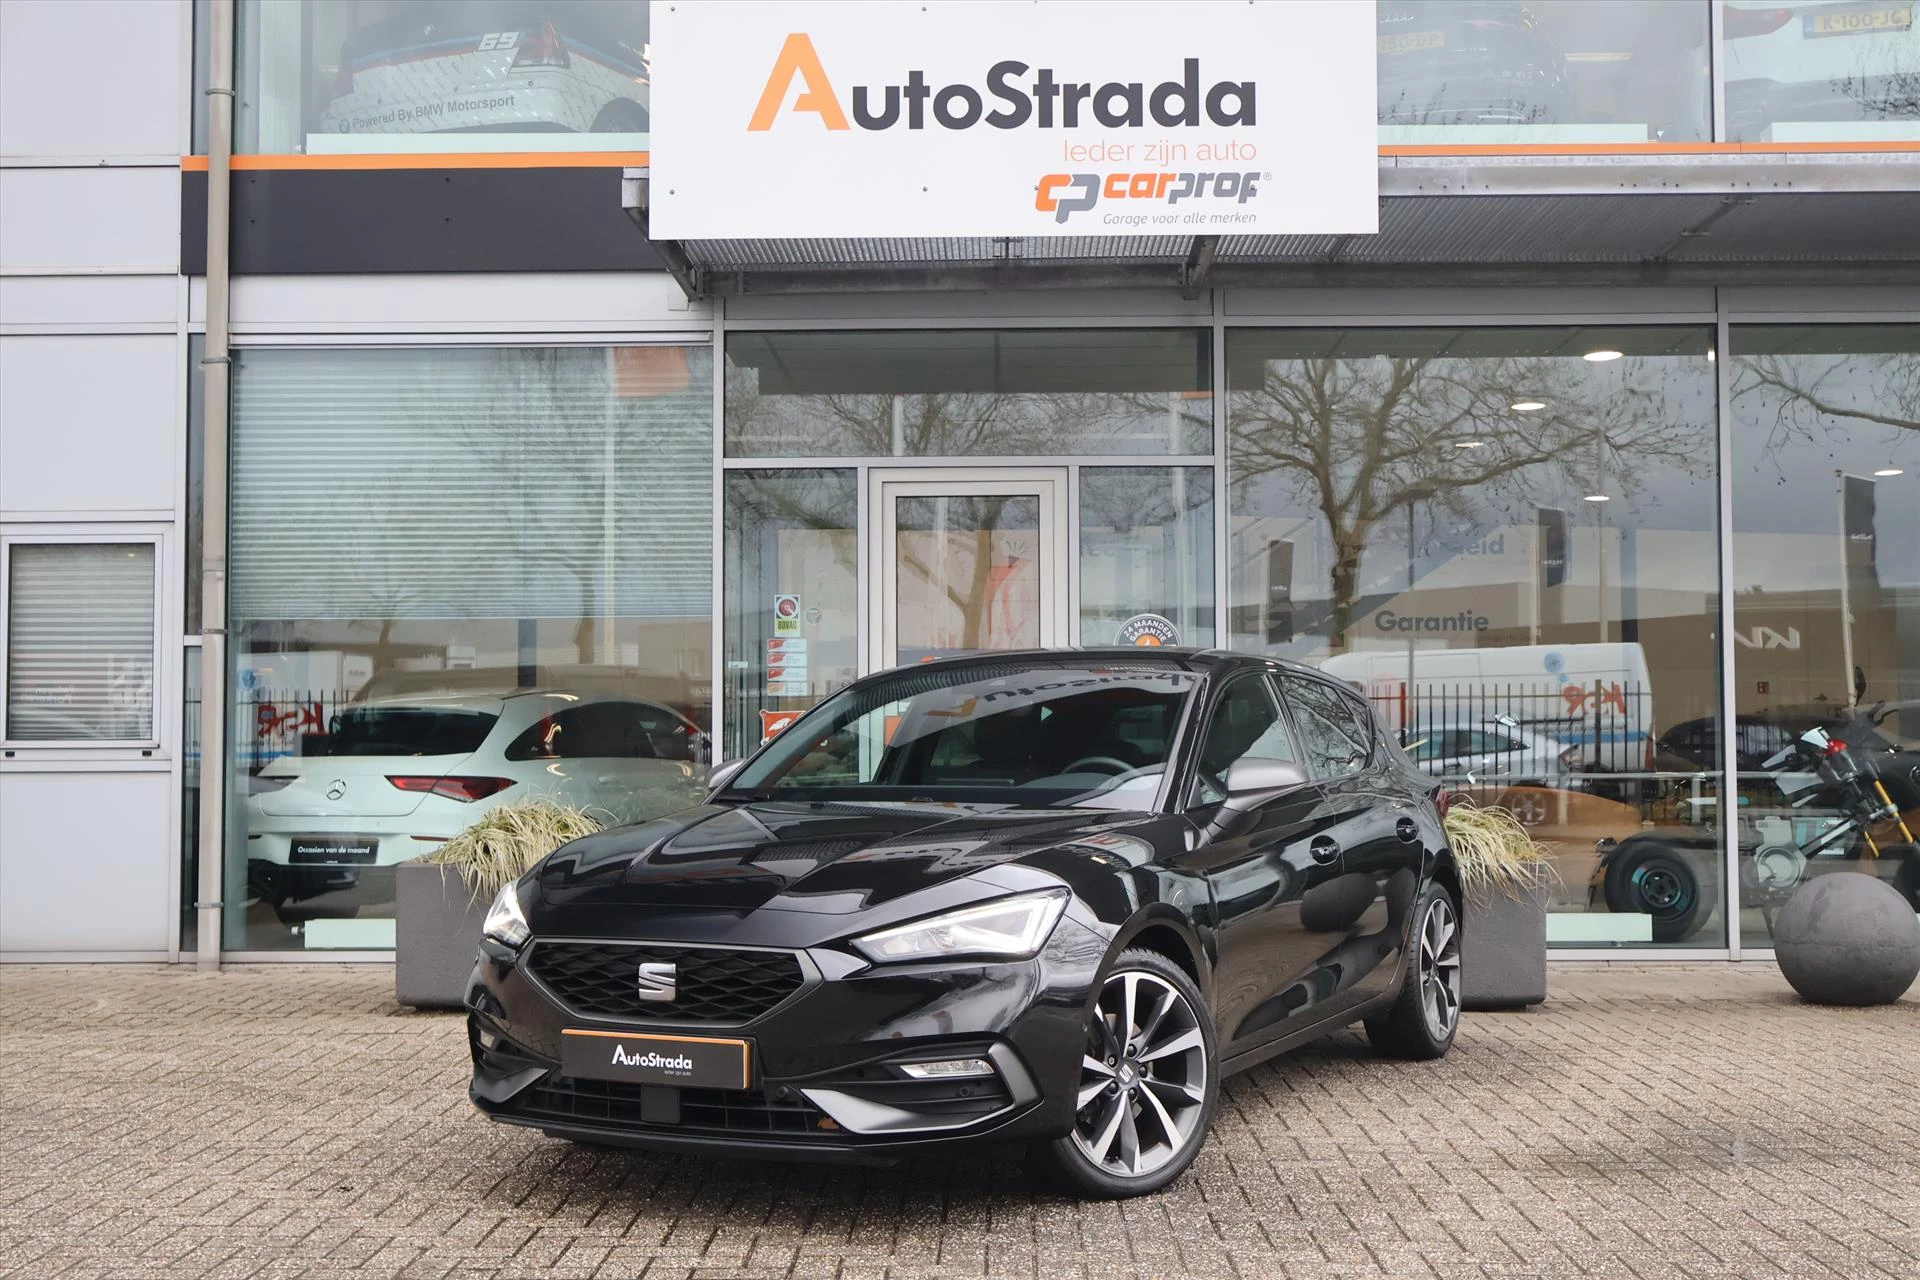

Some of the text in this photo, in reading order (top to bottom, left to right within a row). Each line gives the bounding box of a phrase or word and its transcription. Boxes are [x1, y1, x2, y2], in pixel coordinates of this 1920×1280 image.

[477, 32, 519, 50] 69
[747, 32, 1257, 132] AutoStrada
[352, 111, 395, 128] Powered
[416, 102, 444, 117] BMW
[448, 95, 515, 114] Motorsport
[1144, 140, 1187, 166] zijn
[1196, 142, 1257, 161] auto
[1103, 210, 1257, 227] Garage voor alle merken
[1123, 619, 1174, 638] 24 MAANDEN
[1375, 609, 1489, 632] Garantie
[1129, 627, 1167, 643] GARANTIE
[297, 846, 325, 854] Occasion
[338, 846, 346, 854] de
[347, 846, 370, 854] maand
[611, 1044, 692, 1070] AutoStrada
